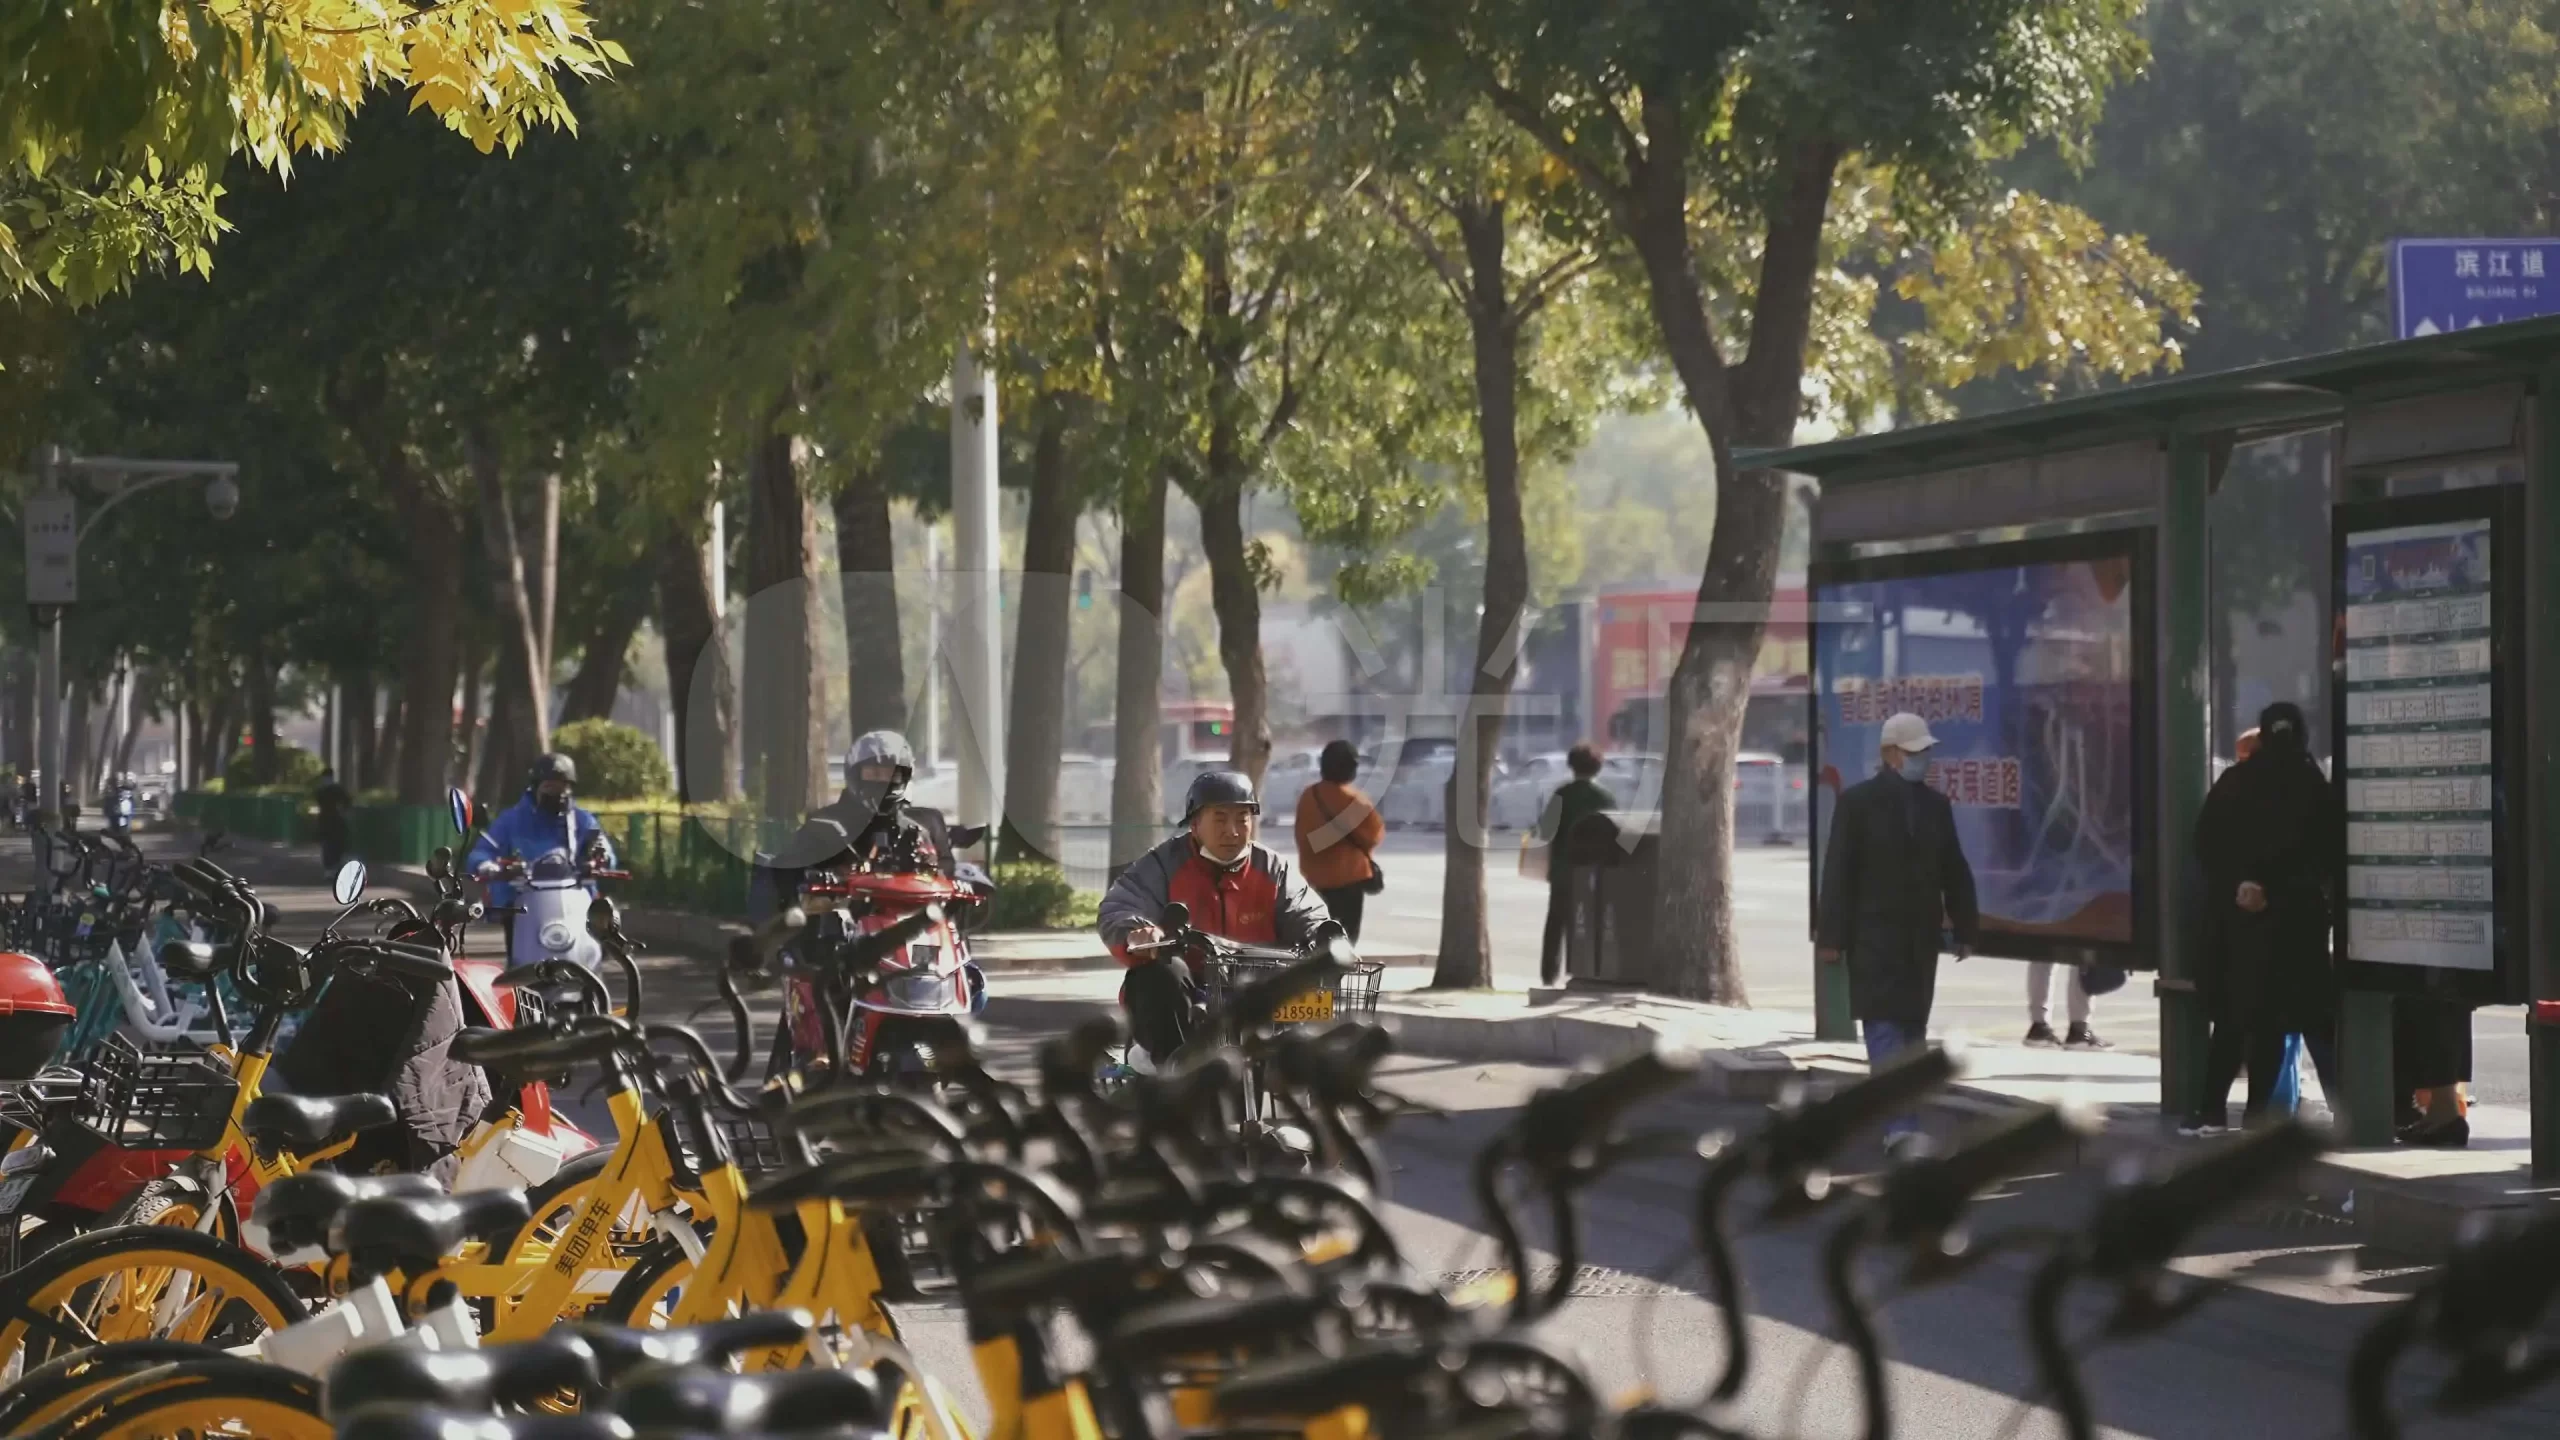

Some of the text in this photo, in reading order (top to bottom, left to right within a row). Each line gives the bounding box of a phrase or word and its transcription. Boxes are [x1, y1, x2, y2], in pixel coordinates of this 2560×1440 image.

[2455, 249, 2545, 278] 滨江道
[554, 1198, 611, 1279] 美团单车
